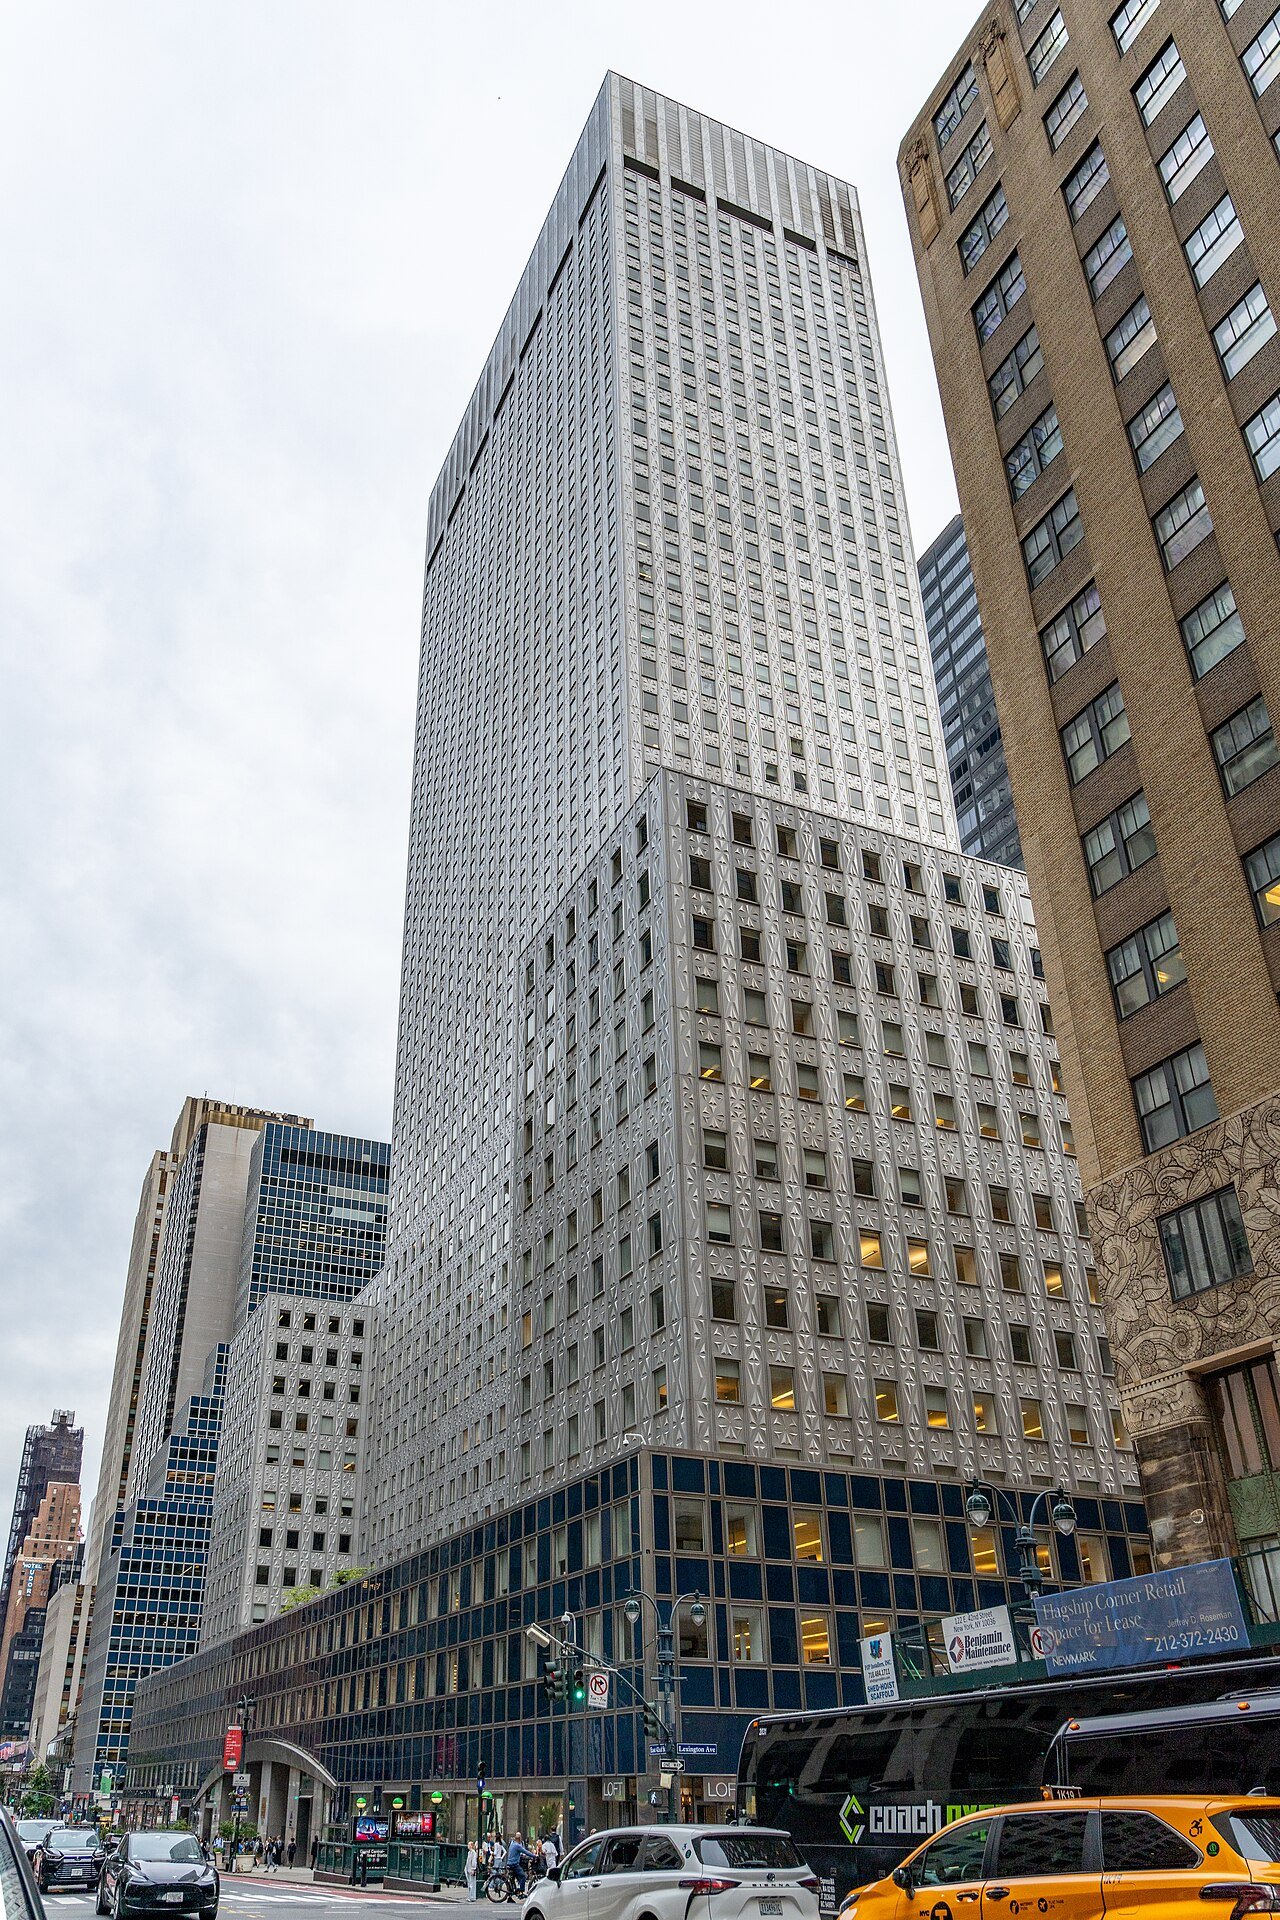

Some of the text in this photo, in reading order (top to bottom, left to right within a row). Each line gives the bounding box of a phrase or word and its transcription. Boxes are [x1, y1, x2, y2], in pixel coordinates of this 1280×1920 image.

[1042, 1577, 1186, 1622] Flagship Corner Retail
[968, 1613, 978, 1621] 42nd
[979, 1610, 993, 1620] Street
[1167, 1618, 1189, 1628] Jeffrey
[1200, 1611, 1232, 1622] Roseman
[1046, 1614, 1142, 1646] Space for Lease
[1154, 1625, 1238, 1652] 212-372-2430
[964, 1630, 1003, 1648] Benjamin
[965, 1643, 1011, 1660] Maintenance
[1052, 1650, 1097, 1667] NEWMARK
[867, 1681, 894, 1693] SHED-HOIST
[871, 1690, 894, 1700] SCAFFOLD
[678, 1746, 704, 1754] Lexington
[604, 1782, 623, 1796] LOFT
[708, 1782, 736, 1797] LOF
[1057, 1790, 1075, 1800] 1K19
[869, 1800, 942, 1834] coach
